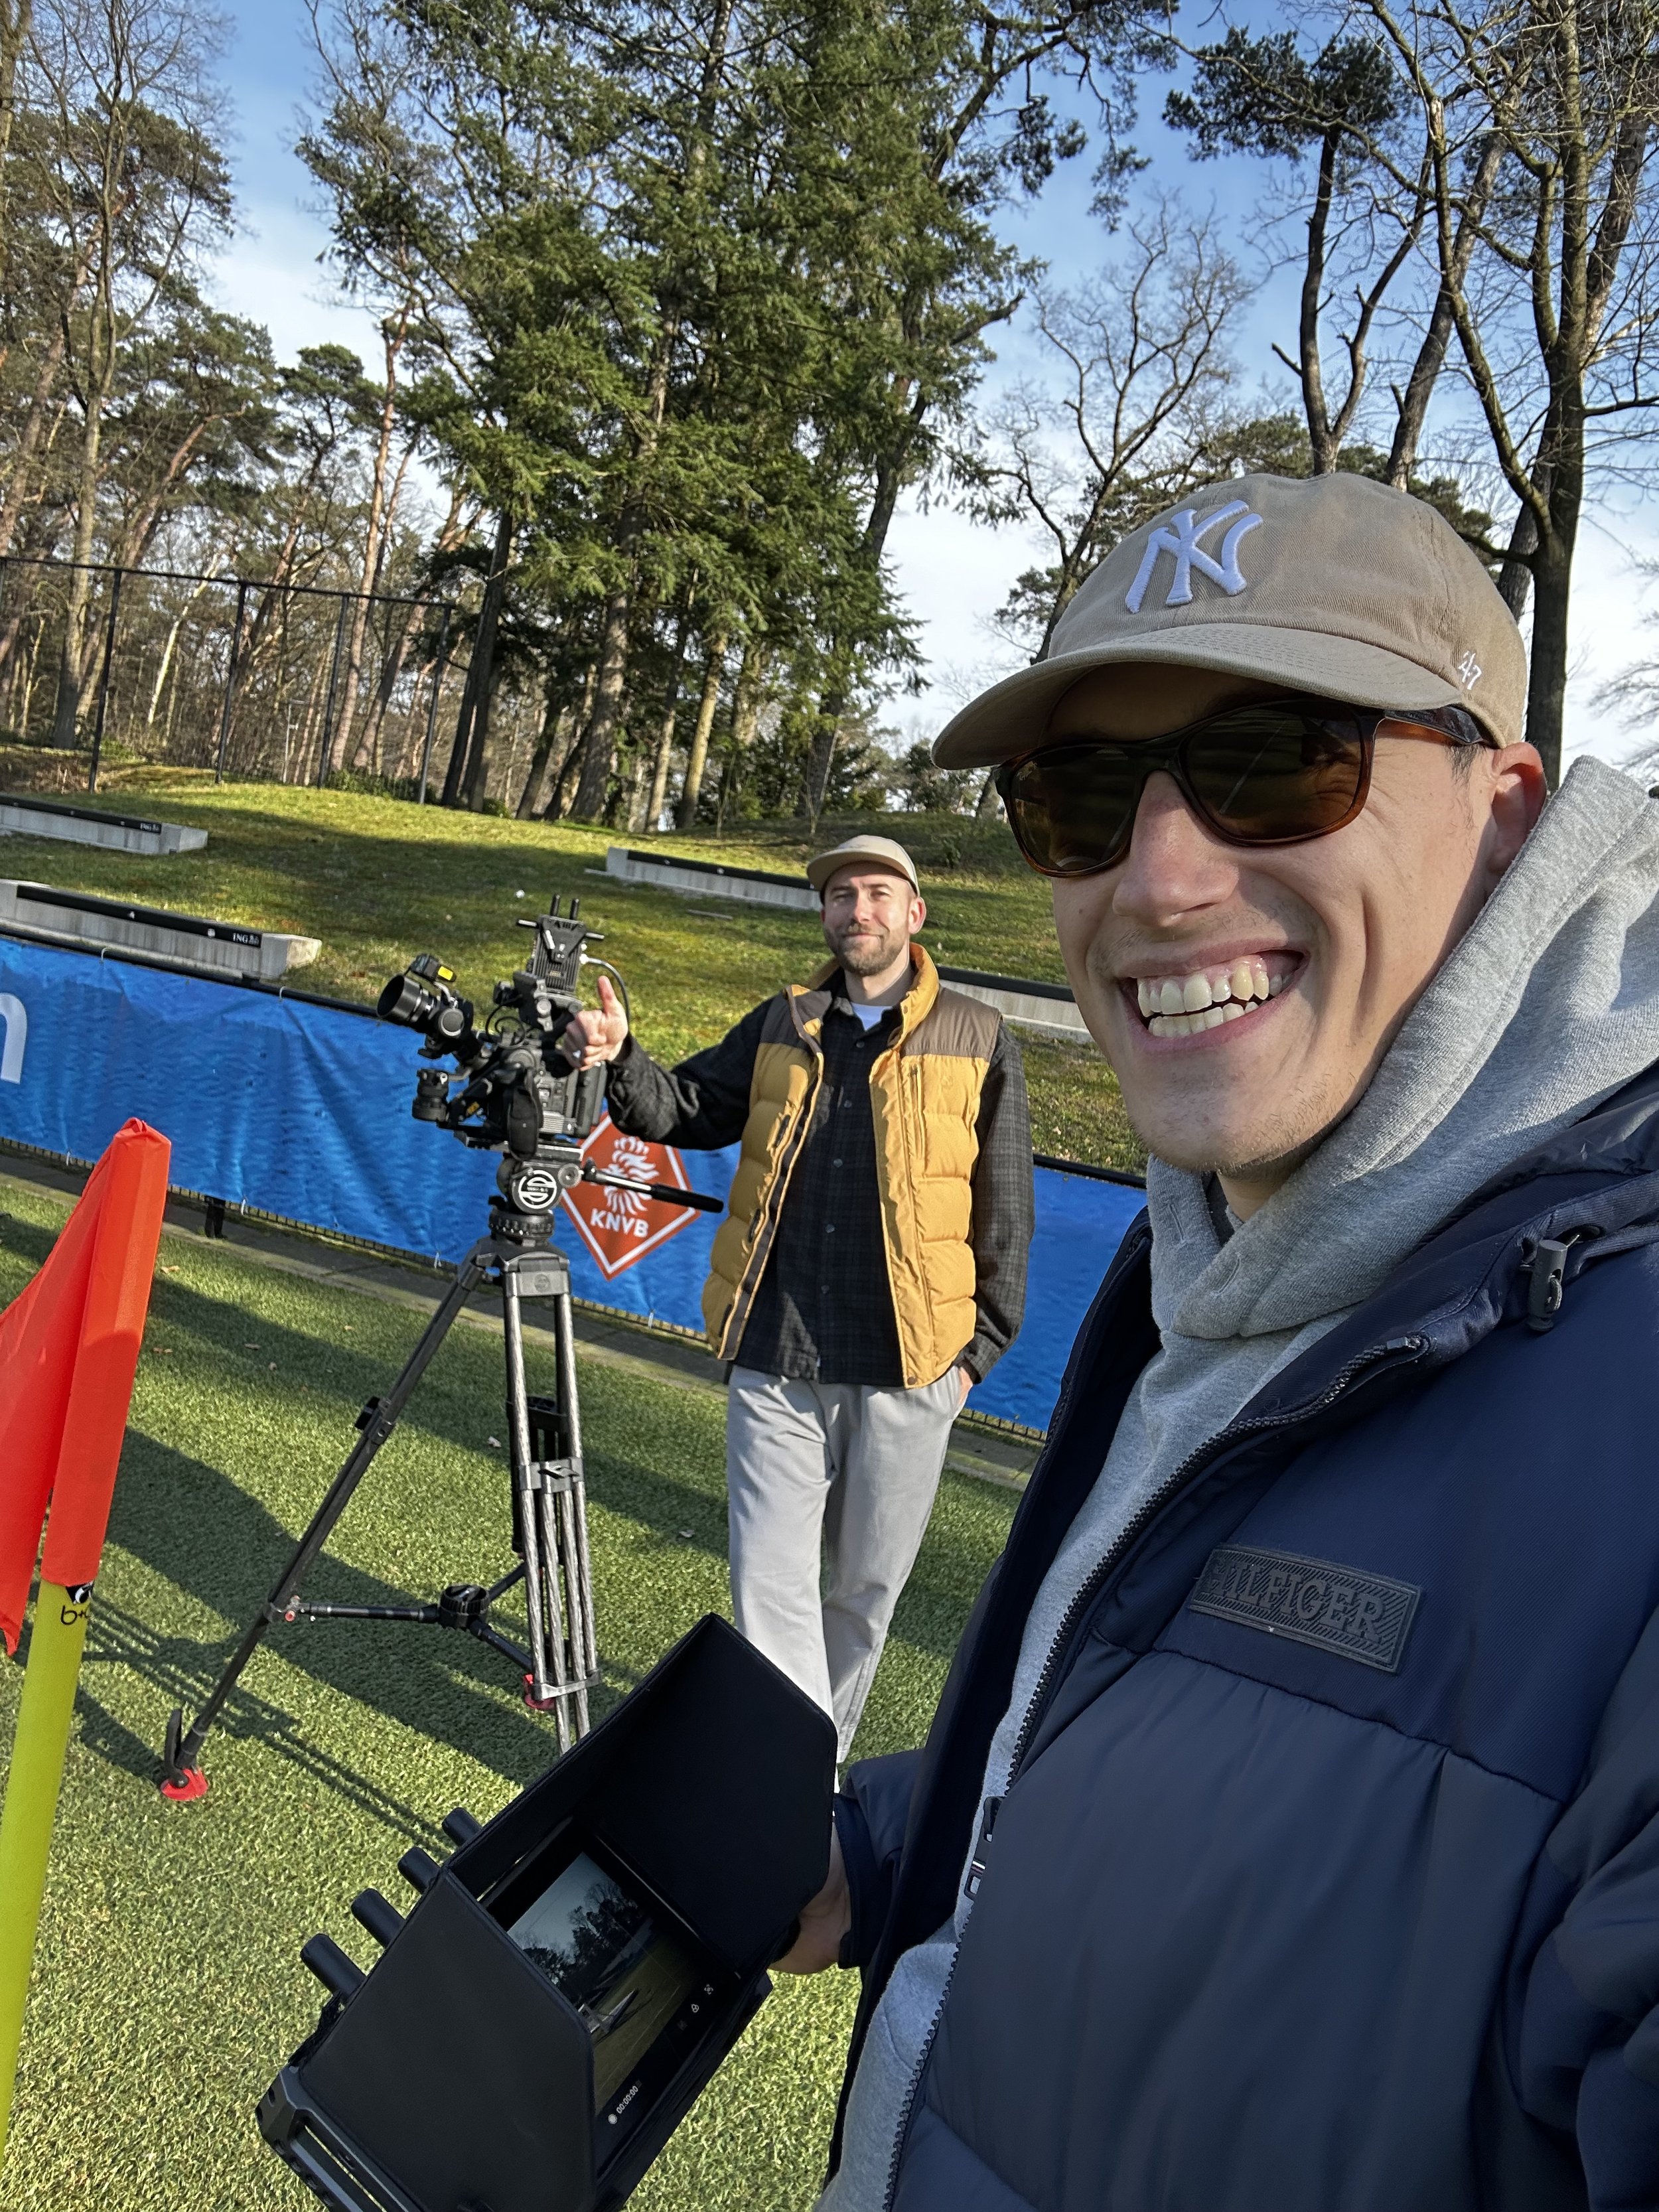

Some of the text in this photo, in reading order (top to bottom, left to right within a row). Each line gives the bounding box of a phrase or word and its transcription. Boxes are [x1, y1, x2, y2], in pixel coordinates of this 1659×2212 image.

[1125, 500, 1263, 614] NY
[232, 932, 249, 944] ING
[590, 1208, 649, 1238] KNVB
[1202, 1558, 1386, 1645] HILFIGER
[616, 2085, 639, 2114] 00:00:00
